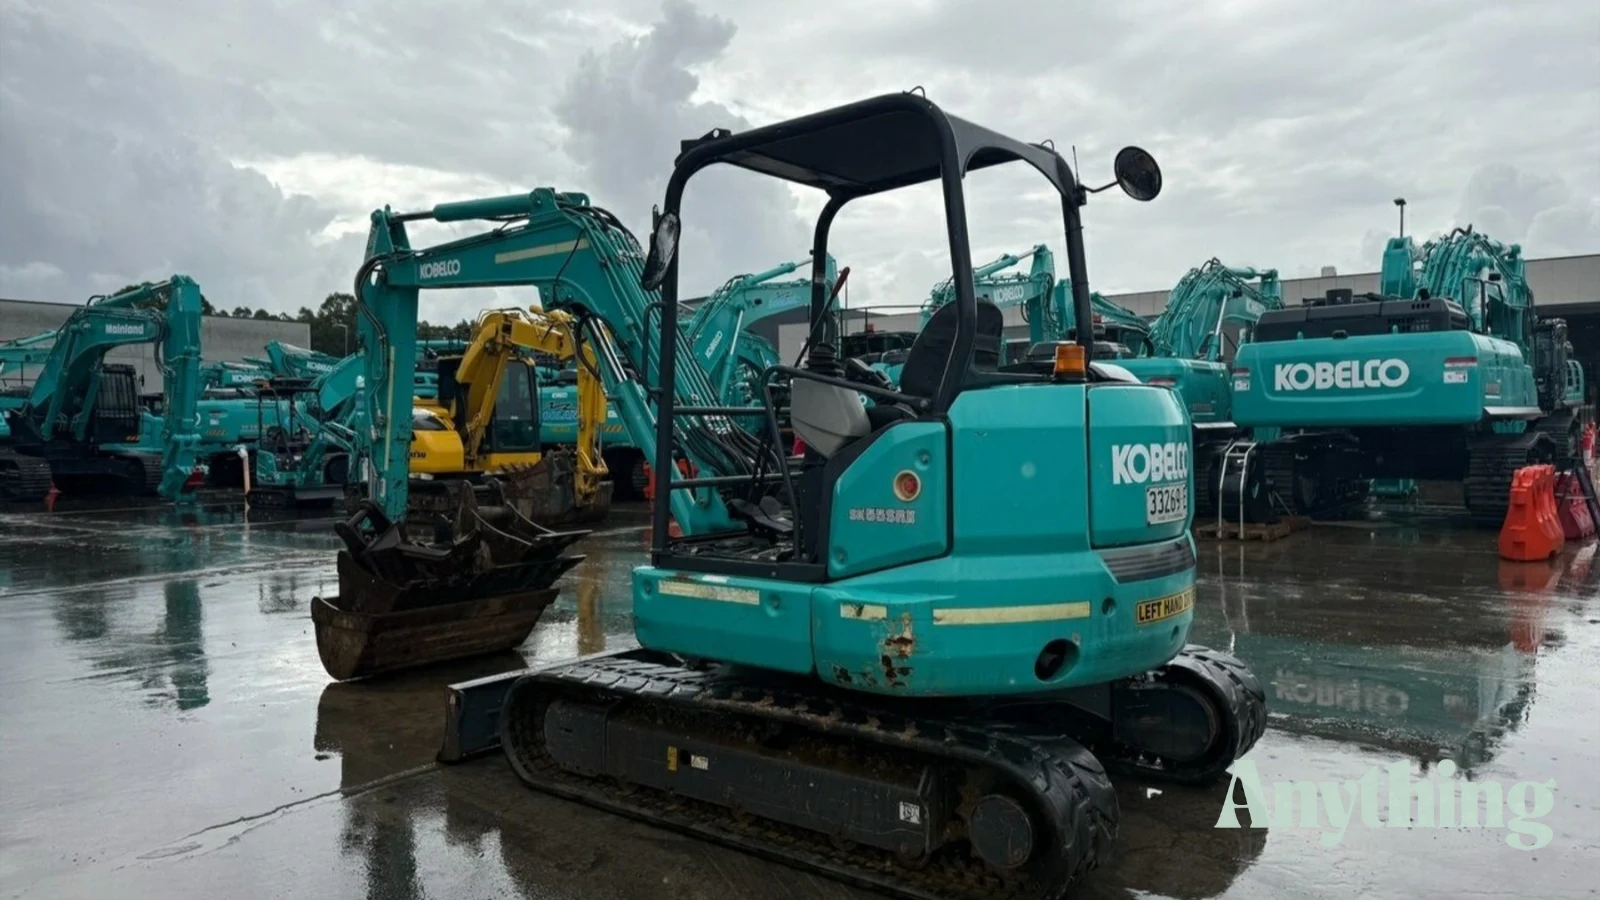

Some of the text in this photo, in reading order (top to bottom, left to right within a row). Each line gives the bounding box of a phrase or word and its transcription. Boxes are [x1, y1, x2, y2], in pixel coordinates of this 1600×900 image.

[420, 260, 461, 279] KOBELCO
[993, 285, 1024, 302] KOBELCO
[105, 323, 144, 334] Mainland
[1275, 359, 1410, 391] KOBELCO
[1139, 601, 1162, 621] LEFT
